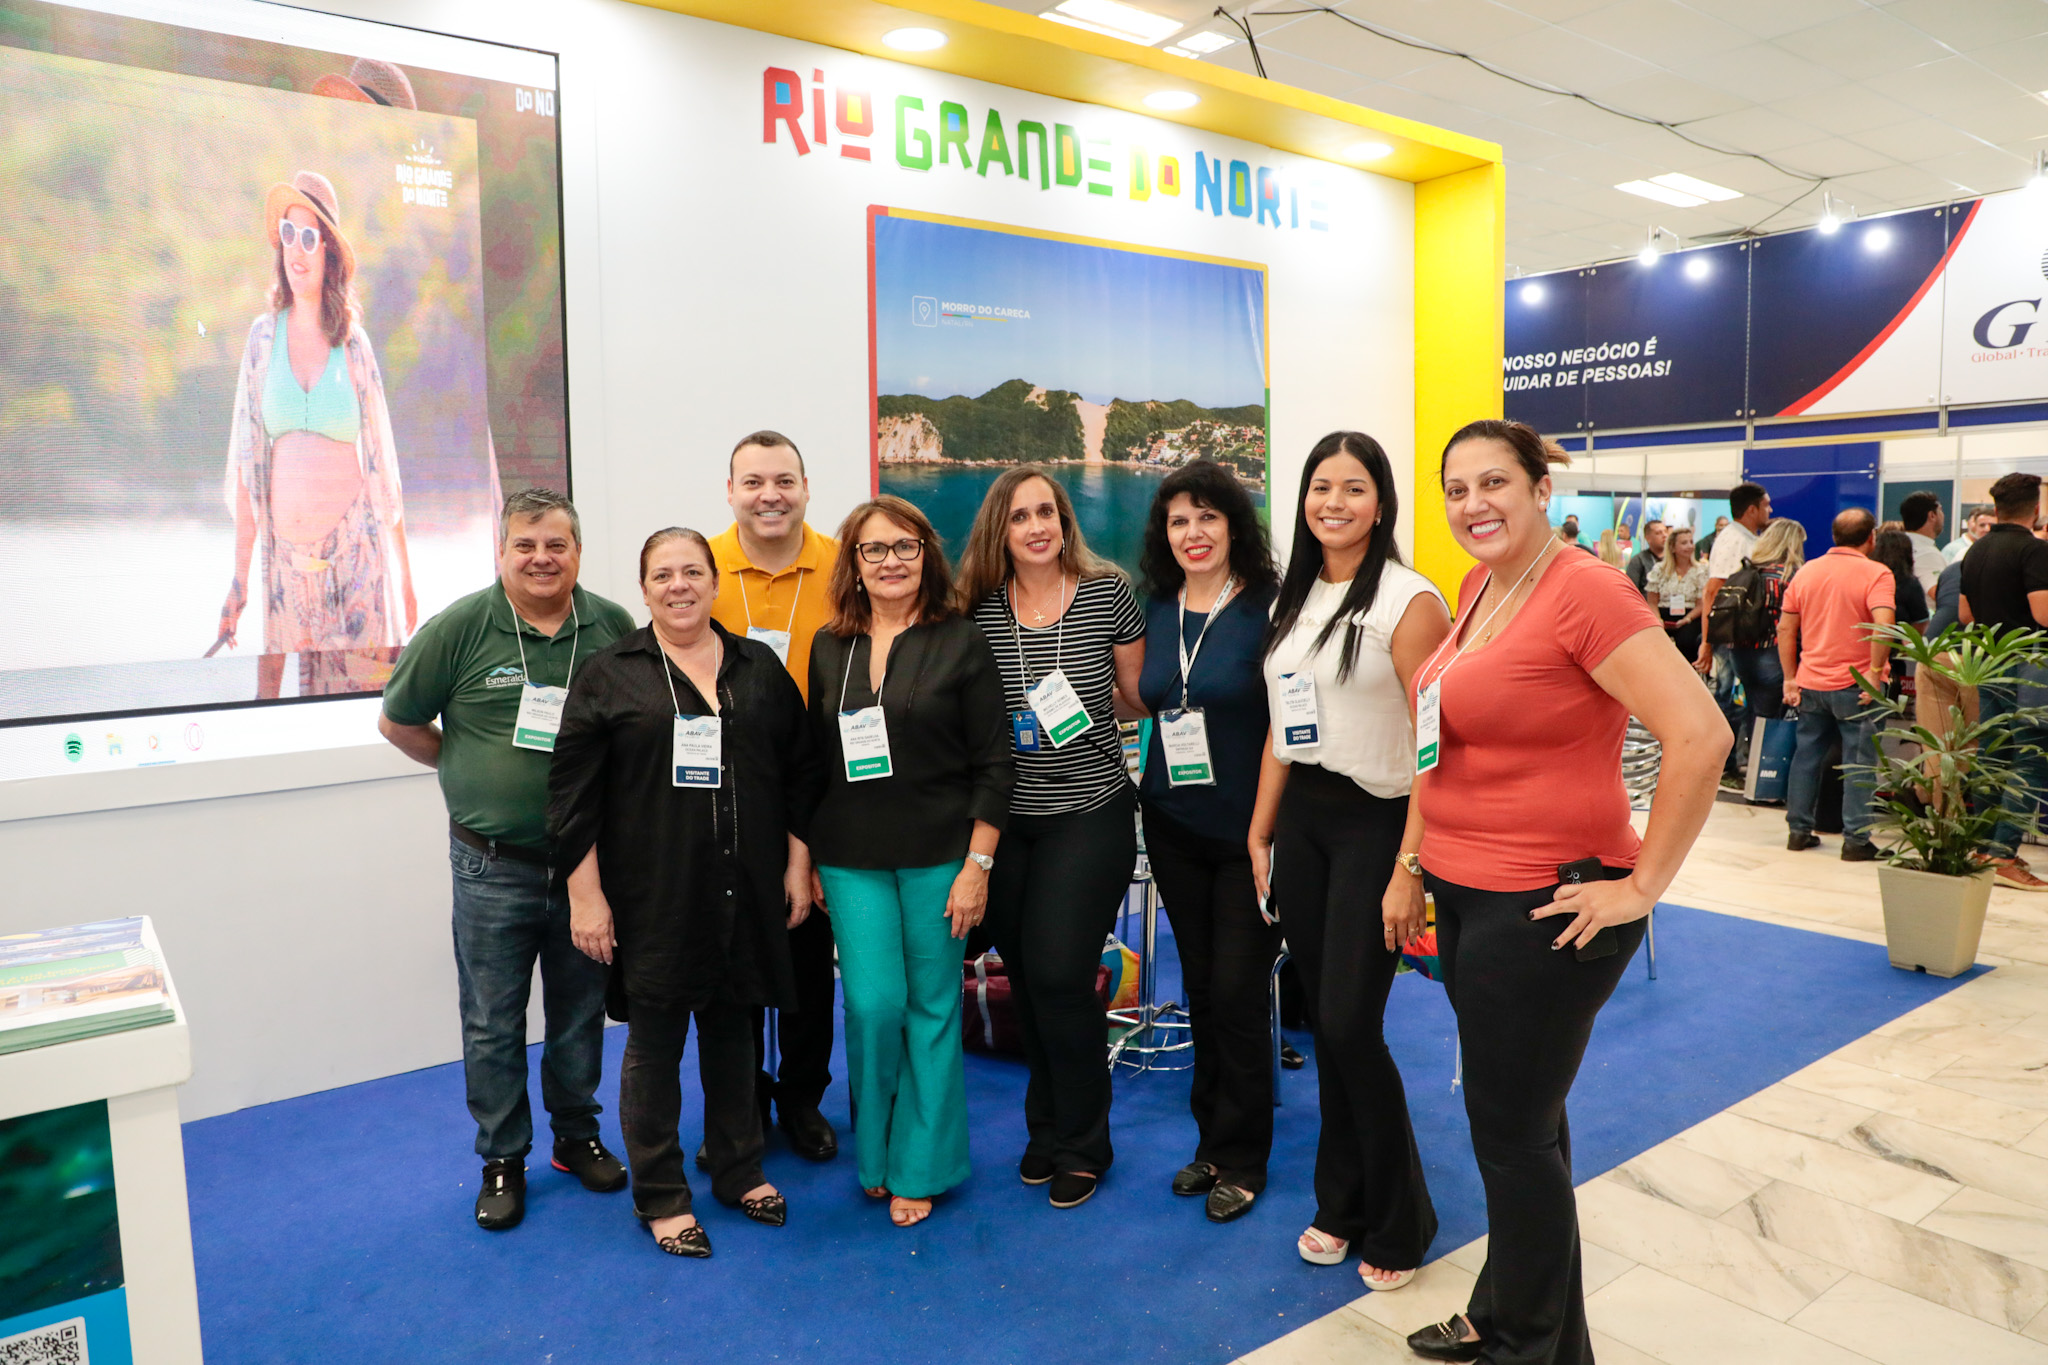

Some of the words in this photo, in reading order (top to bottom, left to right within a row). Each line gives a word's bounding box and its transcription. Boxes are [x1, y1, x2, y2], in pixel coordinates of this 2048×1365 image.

[895, 94, 1113, 197] GRANDE
[942, 301, 977, 314] MORRO
[978, 305, 993, 315] DO
[994, 307, 1031, 319] CARECA
[1503, 352, 1557, 371] NOSSO
[1560, 342, 1640, 366] NEGÓCIO
[1644, 336, 1658, 356] É
[1971, 349, 2017, 363] Global
[1555, 370, 1579, 387] DE
[1582, 360, 1672, 384] PESSOAS!
[1058, 719, 1081, 736] EXPOSITOR
[1292, 728, 1311, 736] VISITANTE
[524, 734, 551, 743] EXPOSITOR
[856, 763, 881, 771] EXPOSITOR
